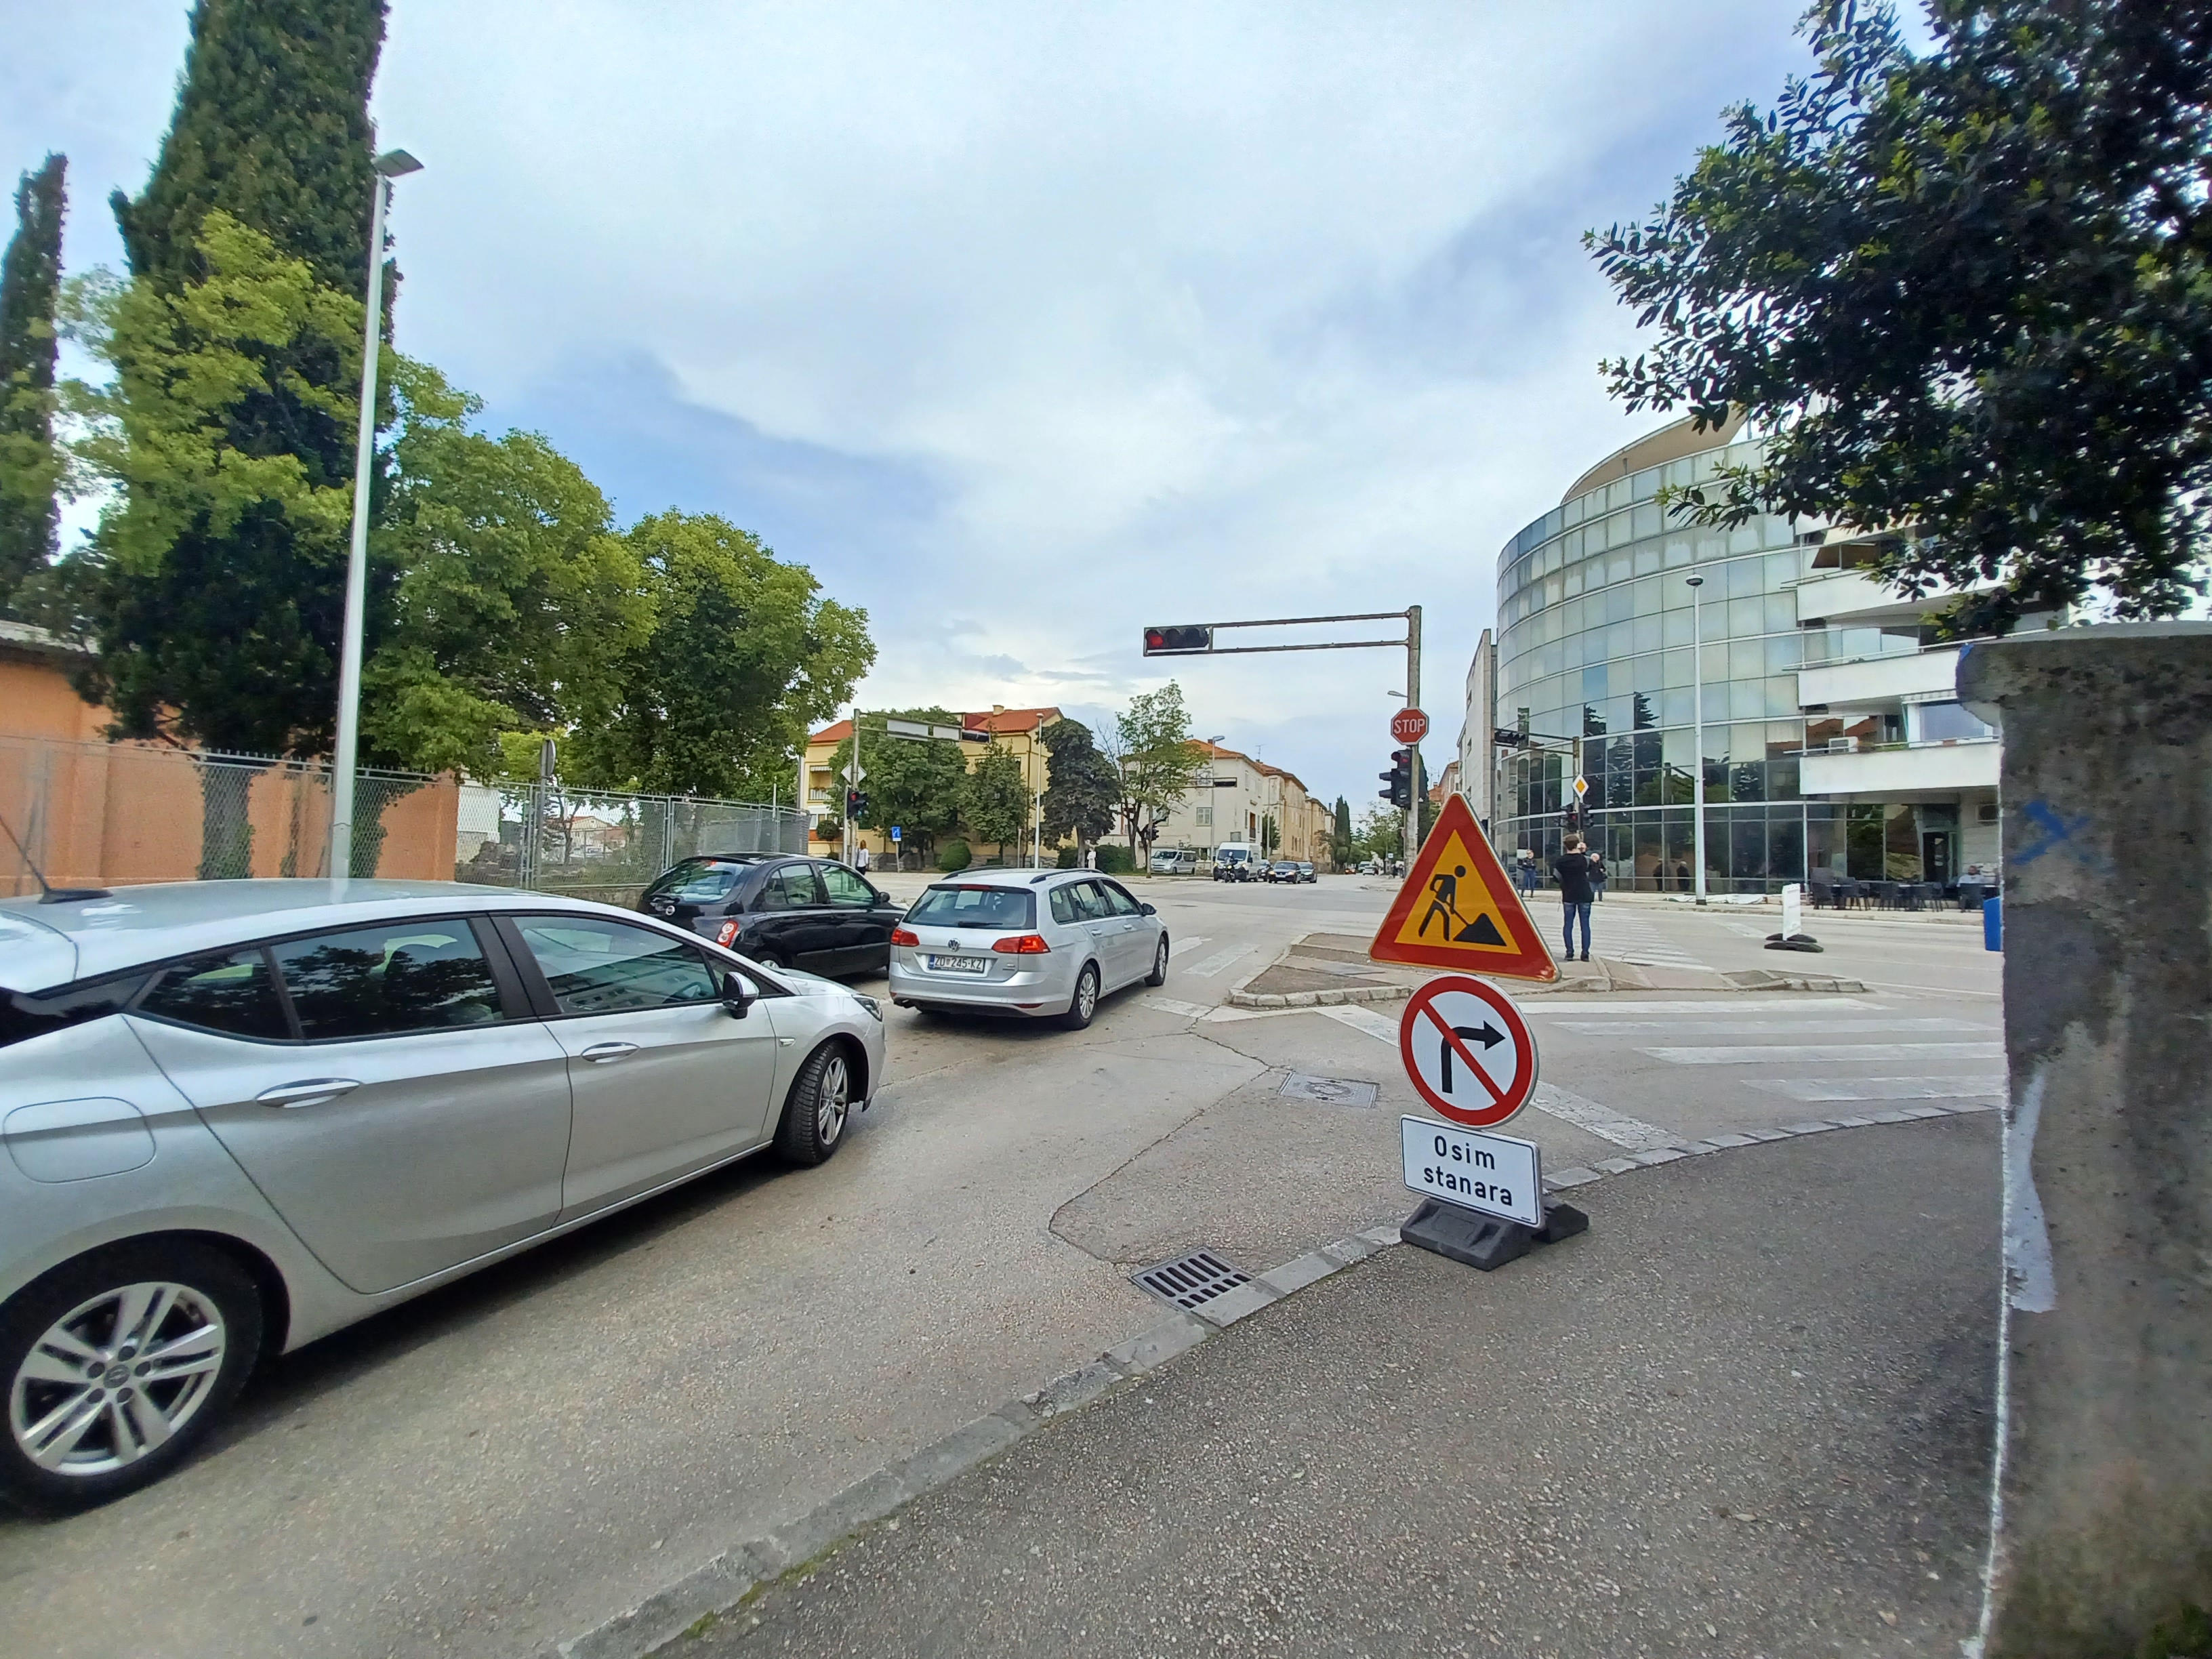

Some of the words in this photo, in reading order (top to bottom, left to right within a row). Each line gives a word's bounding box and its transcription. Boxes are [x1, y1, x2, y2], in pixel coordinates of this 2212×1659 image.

[1393, 718, 1425, 734] STOP
[1434, 1135, 1496, 1170] Osim
[1423, 1166, 1513, 1206] stanara
